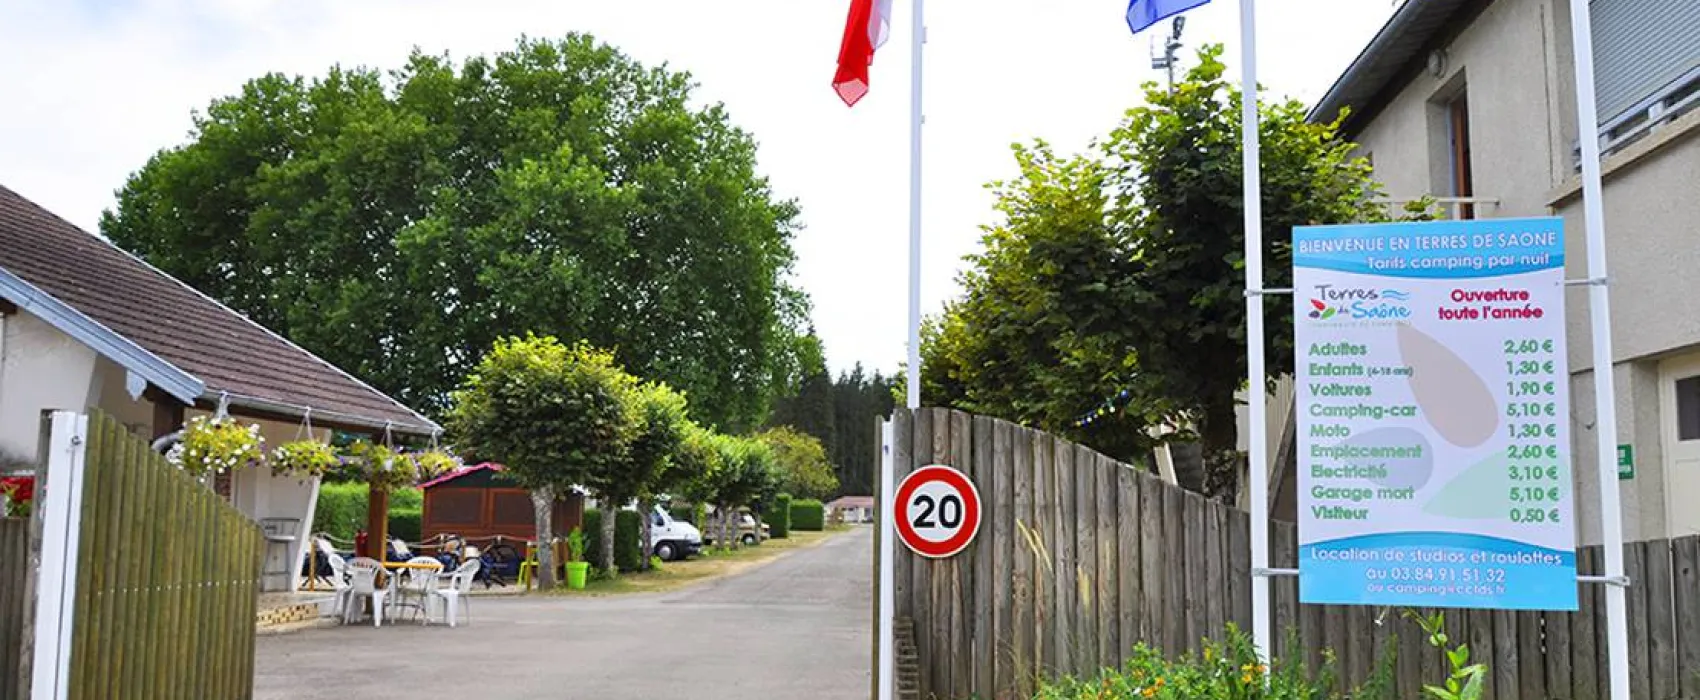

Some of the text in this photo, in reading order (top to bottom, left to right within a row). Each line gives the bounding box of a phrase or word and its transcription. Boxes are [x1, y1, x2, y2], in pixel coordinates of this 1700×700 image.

[1299, 237, 1384, 252] BIENVENUE
[1389, 236, 1410, 250] EN
[1415, 234, 1467, 249] TERRES
[1472, 233, 1493, 247] DE
[1367, 251, 1549, 270] Tarifs camping par nuit
[1314, 284, 1378, 300] Terres
[1451, 289, 1529, 302] Ouverture
[1351, 300, 1412, 318] Saône
[1439, 303, 1543, 320] toute l'année
[1308, 340, 1554, 356] Adultes 2,60 €
[1309, 363, 1364, 376] Enfants
[1506, 361, 1539, 375] 1,30
[1542, 361, 1554, 373] €
[1309, 382, 1555, 396] Voitures 1,90 €
[1310, 403, 1556, 420] Camping-car 5,10 €
[1310, 424, 1557, 438] Moto 1,30 €
[1311, 444, 1557, 460] Emplacement 2,60 €
[1311, 463, 1558, 480] Electricité 3,10 €
[1311, 485, 1560, 502] Garage mort 5,10 €
[913, 494, 961, 528] 20
[1311, 505, 1560, 523] Visiteur 0,50 €
[1311, 547, 1563, 566] Location de studios et roulottes
[1366, 568, 1387, 580] au
